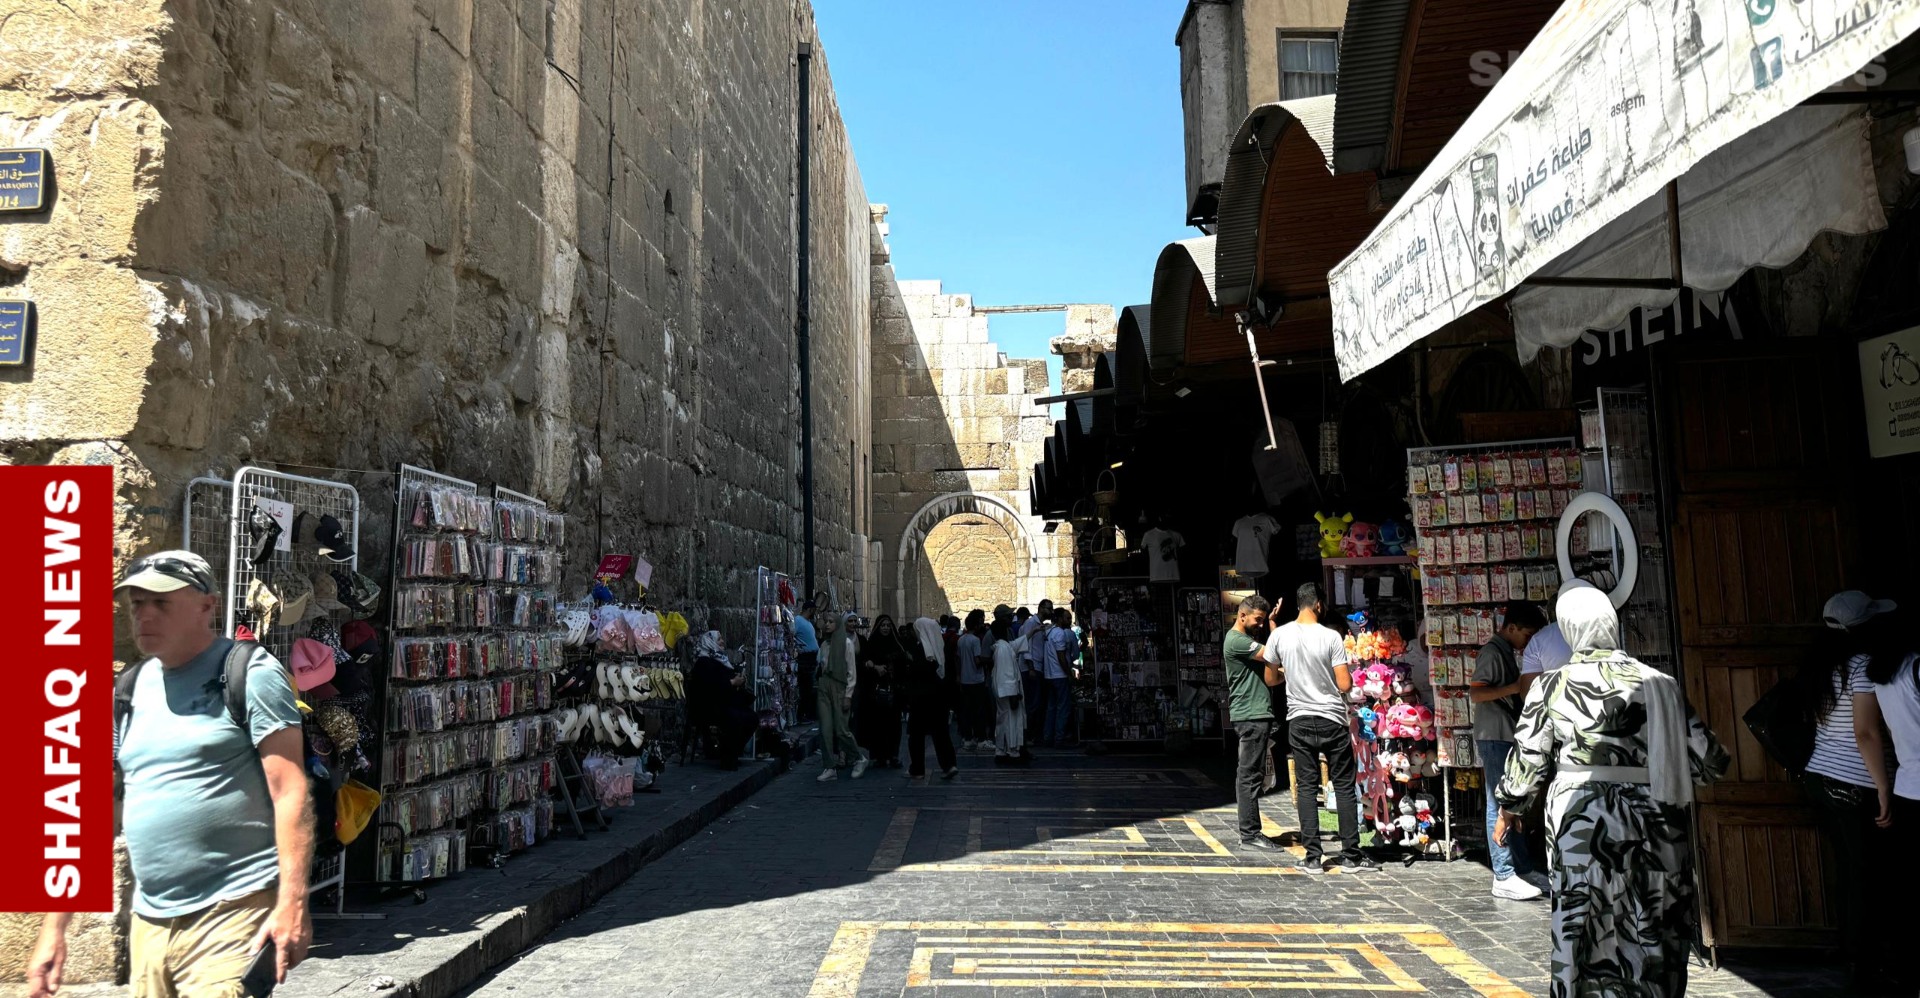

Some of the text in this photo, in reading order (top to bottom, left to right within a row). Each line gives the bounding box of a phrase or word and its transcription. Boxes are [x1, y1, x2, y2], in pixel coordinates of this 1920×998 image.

[1610, 94, 1645, 118] aseem
[1507, 128, 1592, 208] طباعة كفرات
[1531, 193, 1575, 241] فورية
